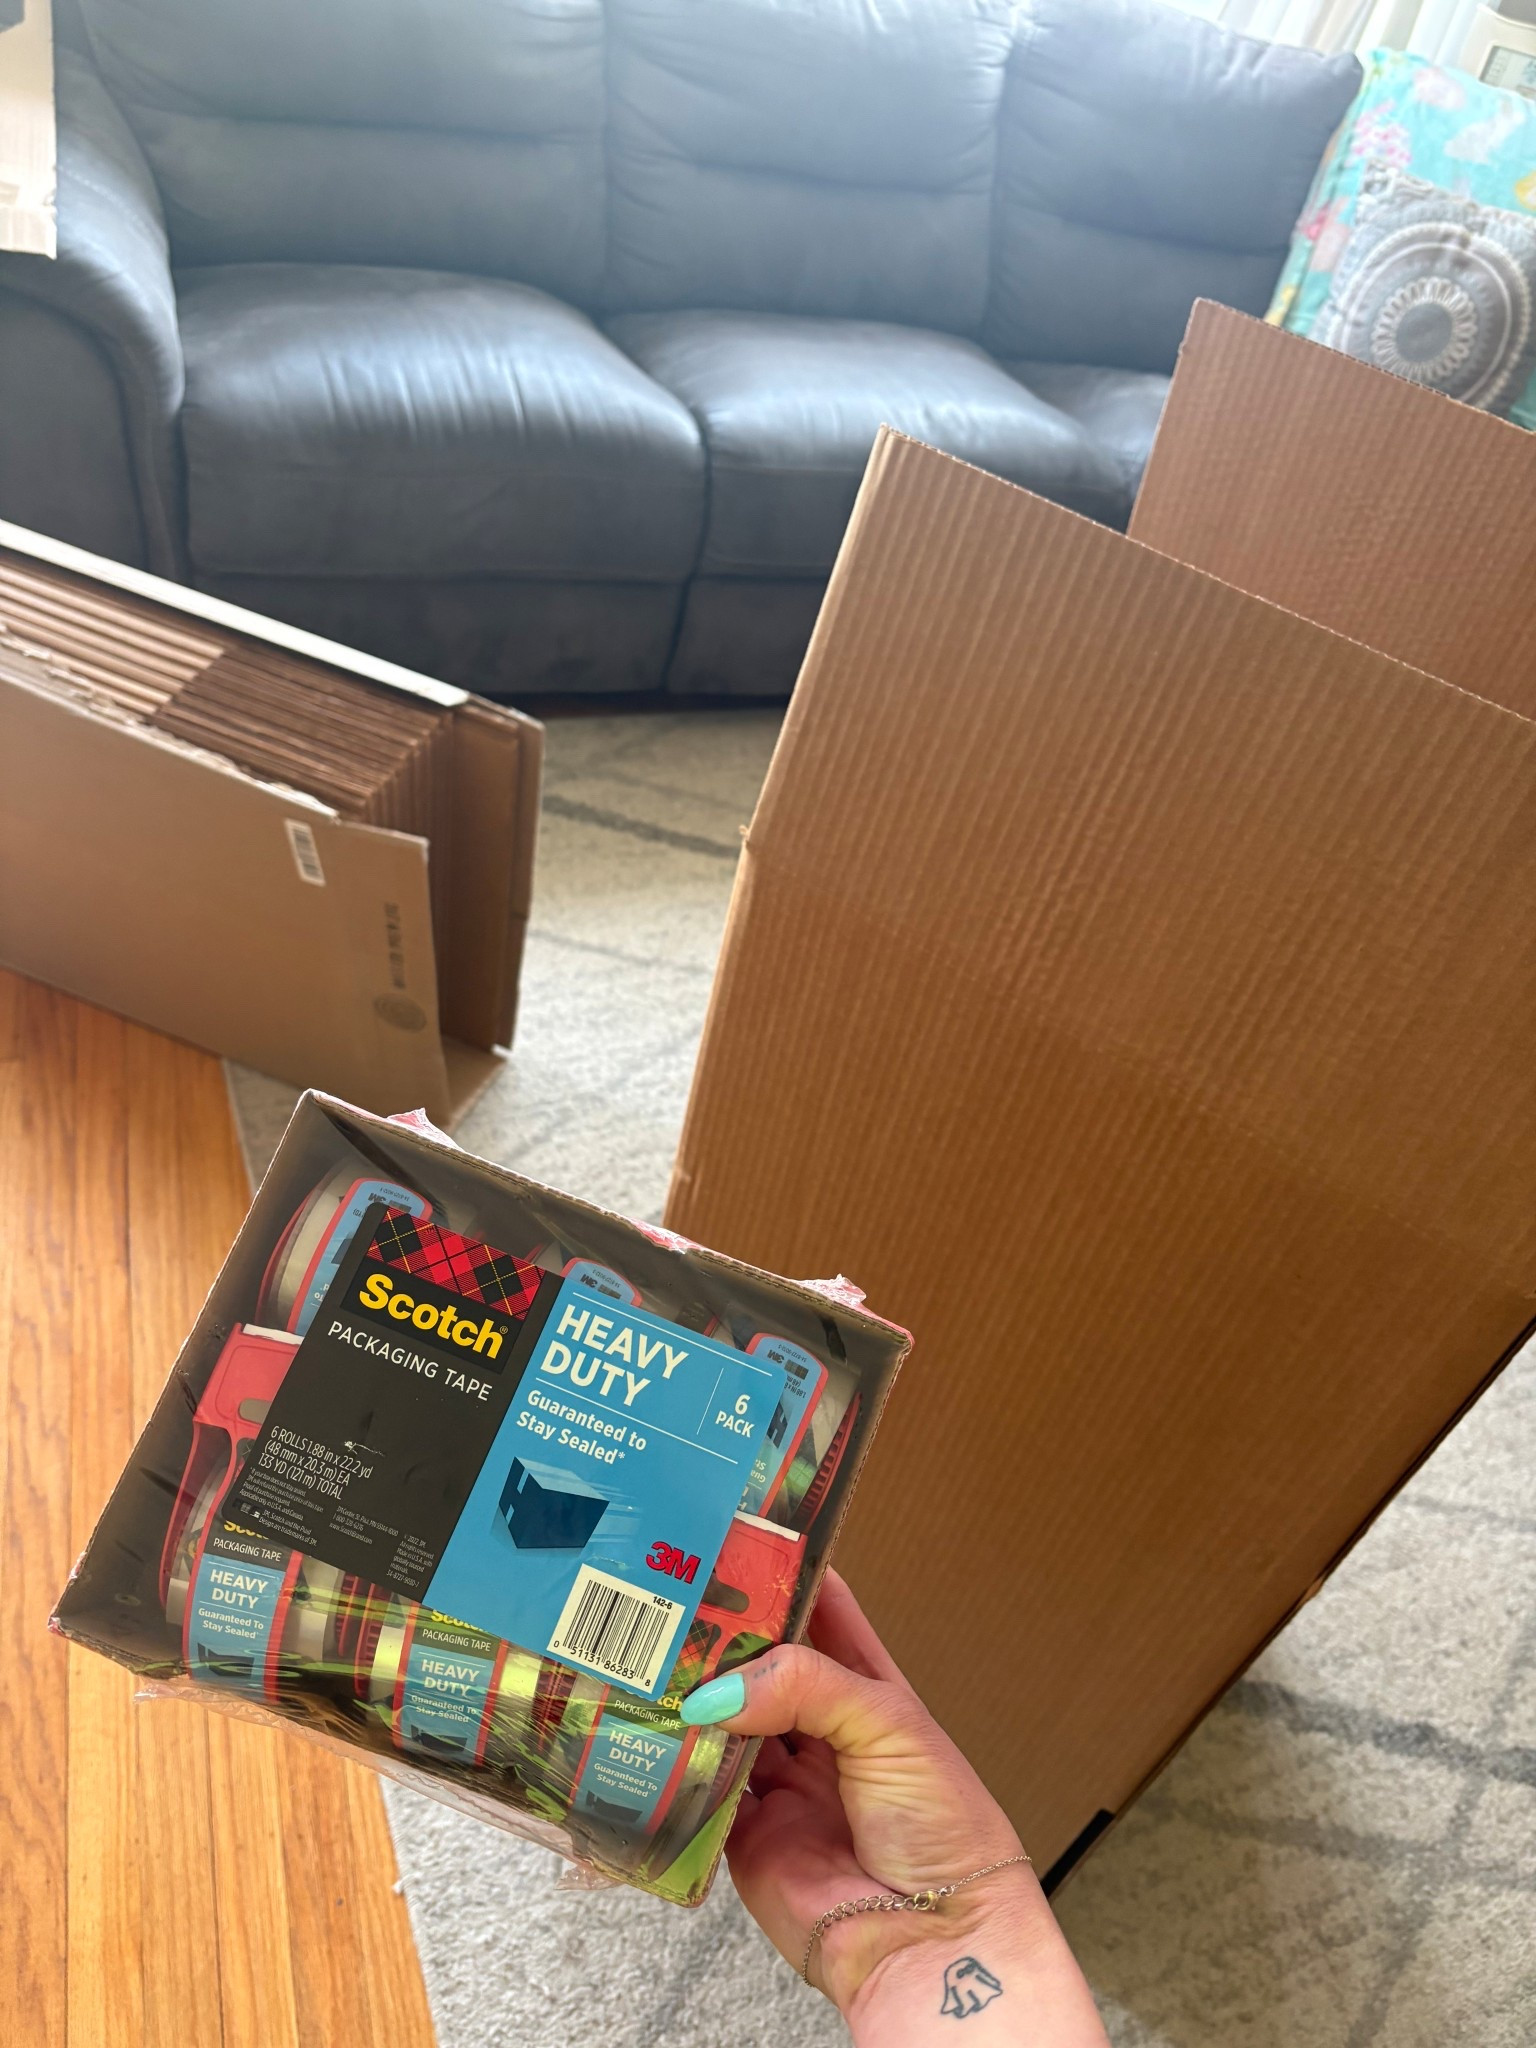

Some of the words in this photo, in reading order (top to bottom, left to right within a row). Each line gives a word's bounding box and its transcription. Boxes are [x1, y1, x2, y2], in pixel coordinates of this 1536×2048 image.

[580, 1274, 598, 1288] 3M
[556, 1304, 689, 1380] HEAVY
[328, 1321, 439, 1378] PACKAGING
[444, 1368, 493, 1401] TAPE
[767, 1350, 785, 1364] 3M
[540, 1340, 651, 1406] DUTY
[735, 1394, 751, 1415] 6
[516, 1412, 556, 1441] Stay
[527, 1389, 627, 1443] Guaranteed
[628, 1429, 647, 1451] to
[715, 1411, 754, 1438] PACK
[264, 1439, 281, 1457] (48
[280, 1448, 298, 1463] mm
[298, 1456, 304, 1465] x
[323, 1465, 337, 1481] m)
[337, 1470, 351, 1486] EA
[271, 1426, 279, 1438] 6
[278, 1429, 308, 1450] ROLLS
[306, 1441, 325, 1458] 1.88
[324, 1448, 334, 1462] in
[333, 1455, 340, 1465] x
[340, 1455, 361, 1473] 22.2
[358, 1463, 373, 1481] yd
[258, 1453, 274, 1469] 133
[273, 1459, 287, 1475] YD
[285, 1465, 304, 1484] (121
[302, 1472, 316, 1489] m)
[316, 1478, 345, 1500] TOTAL
[213, 1538, 259, 1556] PACKAGING
[261, 1549, 282, 1562] TAPE
[646, 1541, 701, 1584] 3M
[210, 1569, 268, 1594] HEAVY
[212, 1588, 259, 1609] DUTY
[653, 1596, 672, 1610] 142-6
[198, 1608, 251, 1626] Guaranteed
[253, 1620, 264, 1630] To
[203, 1620, 222, 1632] Stay
[422, 1629, 469, 1647] PACKAGING
[471, 1639, 491, 1652] TAPE
[421, 1659, 480, 1682] HEAVY
[554, 1640, 559, 1648] 0
[570, 1646, 601, 1666] 51131
[604, 1660, 635, 1680] 86283
[645, 1679, 651, 1687] 8
[424, 1676, 471, 1698] DUTY
[411, 1695, 465, 1712] Guaranteed
[467, 1706, 477, 1715] To
[615, 1699, 659, 1723] PACKAGING
[660, 1716, 682, 1730] TAPE
[609, 1730, 667, 1760] HEAVY
[608, 1747, 656, 1772] DUTY
[594, 1762, 646, 1787] Guaranteed
[647, 1782, 658, 1792] To
[597, 1774, 616, 1789] Stay
